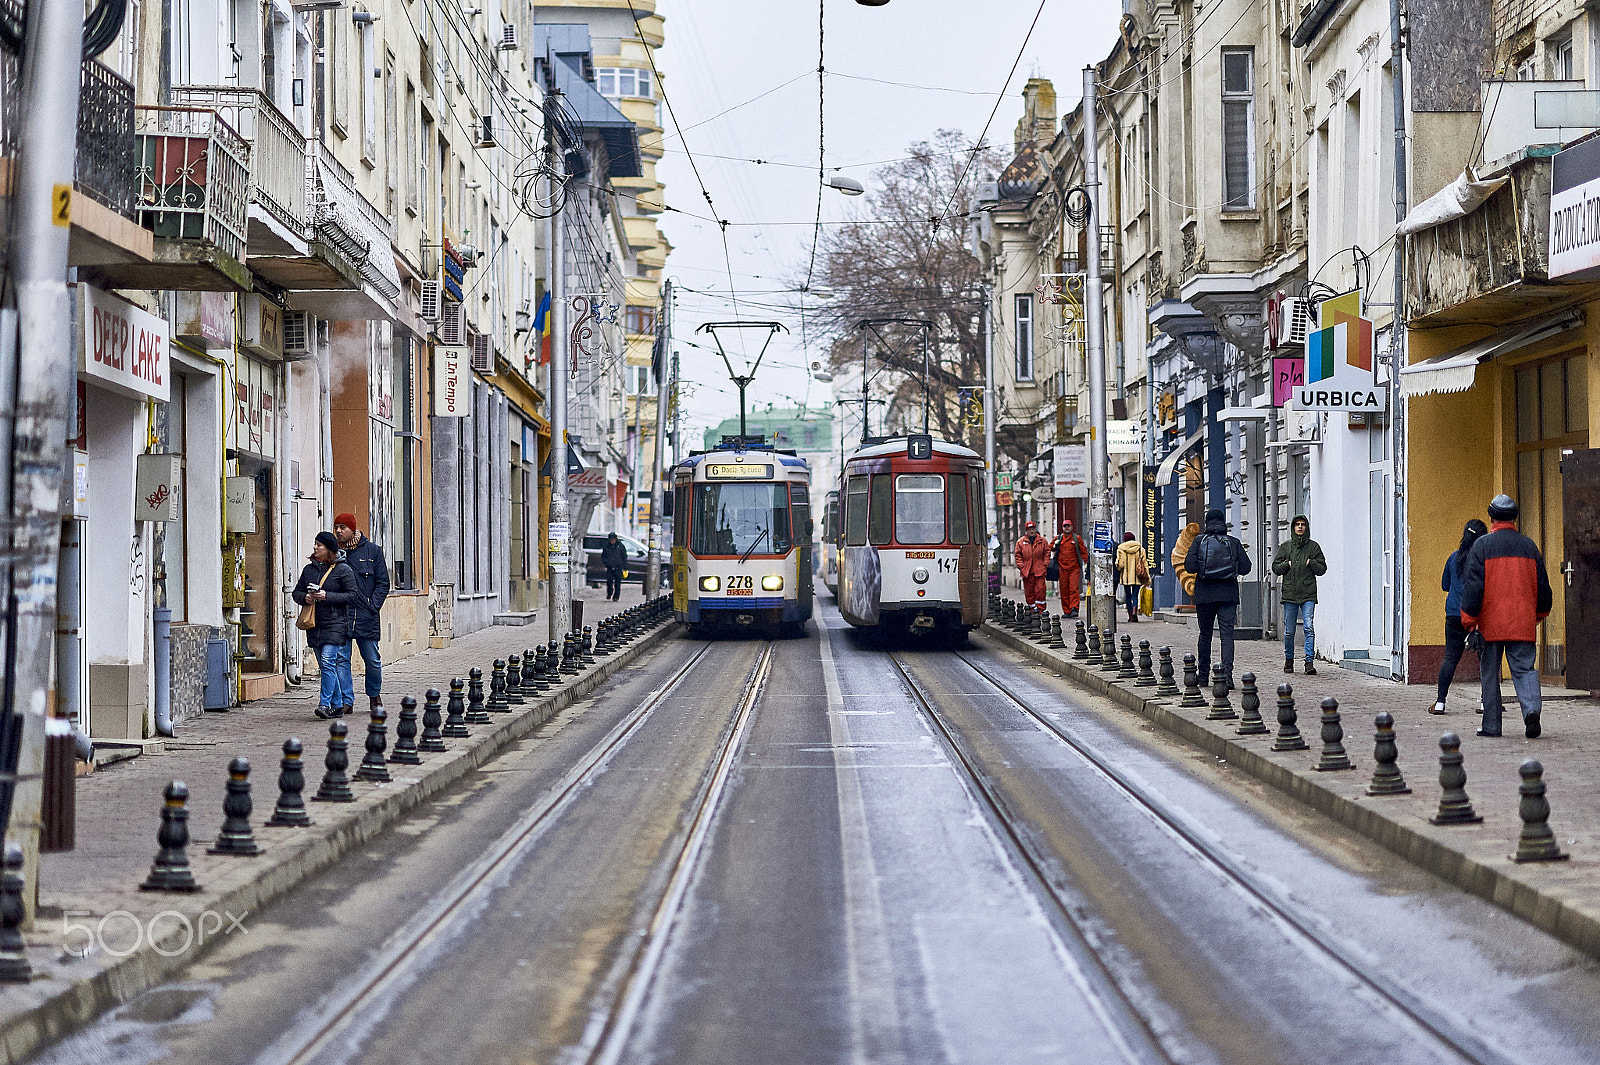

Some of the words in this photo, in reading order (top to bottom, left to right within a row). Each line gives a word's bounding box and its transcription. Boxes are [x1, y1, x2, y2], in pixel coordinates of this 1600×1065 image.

[58, 190, 70, 220] 2
[93, 306, 128, 372] DEEP
[131, 324, 162, 386] LAKE
[1301, 390, 1379, 407] URBICA
[712, 465, 719, 475] 6
[1144, 488, 1157, 528] Boutique
[937, 557, 958, 573] 147
[727, 575, 753, 589] 278
